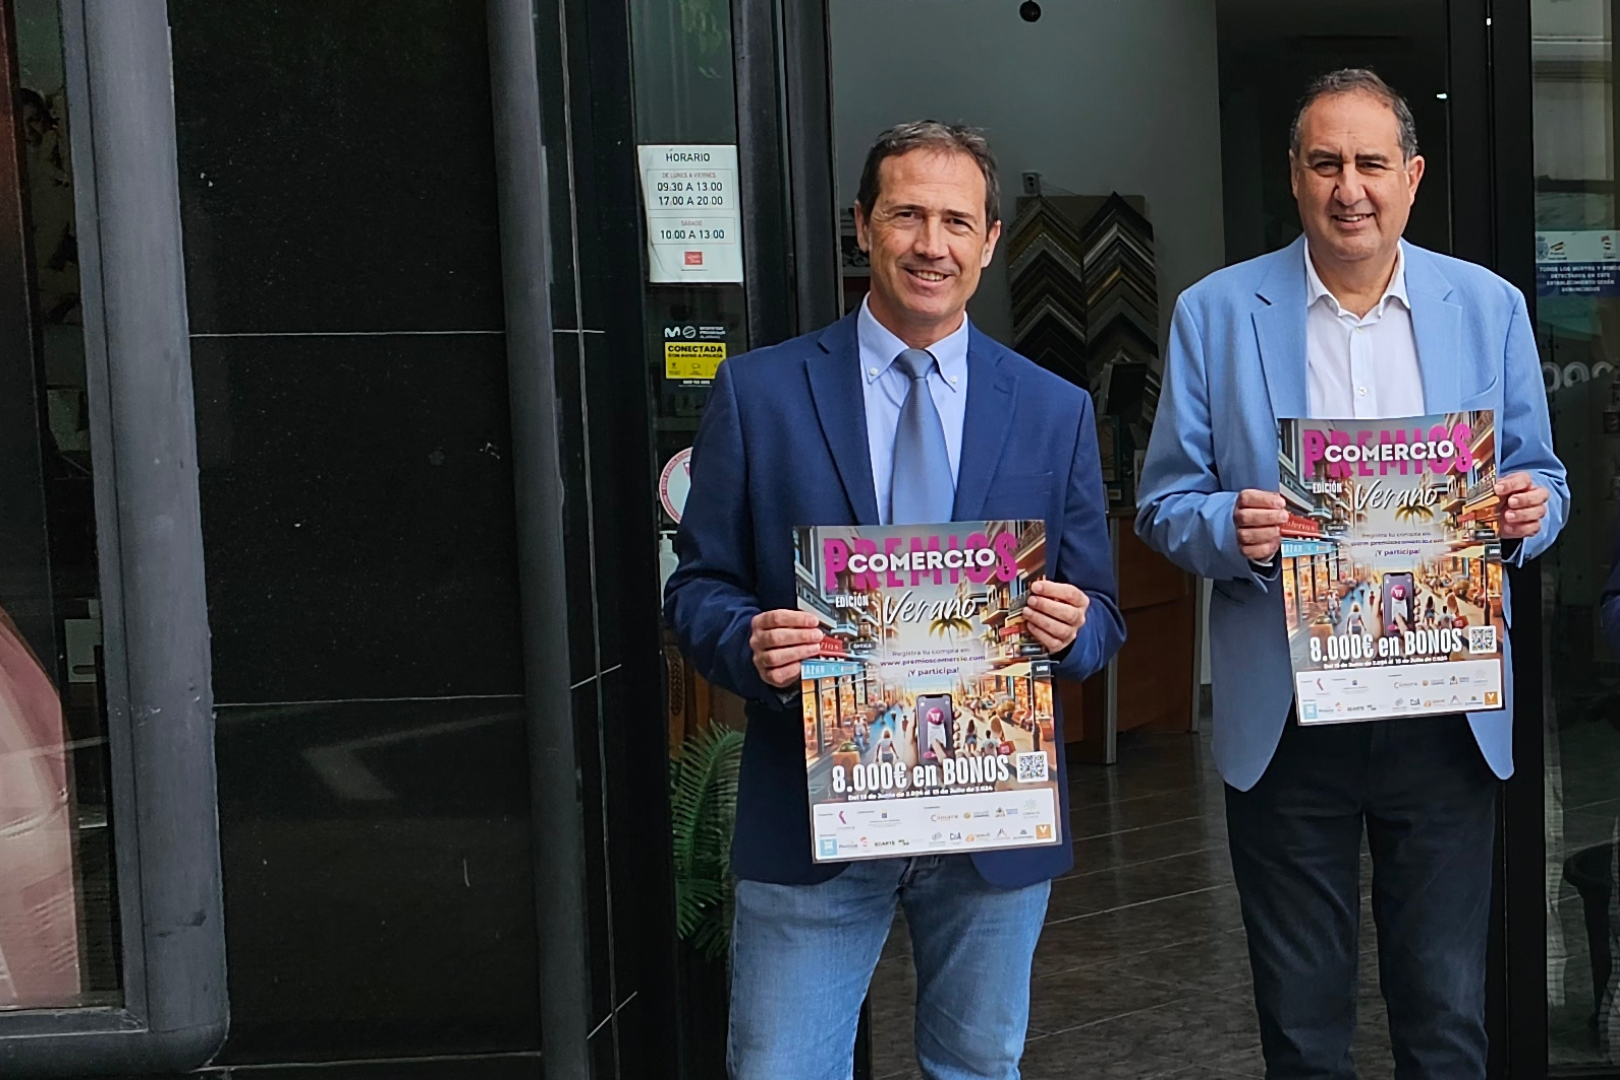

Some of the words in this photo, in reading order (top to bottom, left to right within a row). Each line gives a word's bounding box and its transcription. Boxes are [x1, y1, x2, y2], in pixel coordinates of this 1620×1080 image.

[666, 153, 711, 162] HORARIO
[685, 182, 694, 191] A
[686, 196, 695, 206] A
[688, 230, 697, 239] A
[667, 345, 723, 353] CONECTADA
[1303, 423, 1473, 478] PREMIOS
[1324, 440, 1455, 463] COMERCIO
[1353, 478, 1438, 510] Verano
[823, 531, 1019, 591] PREMIOS
[848, 548, 996, 574] COMERCIO
[835, 592, 870, 608] EDICIÓN
[883, 589, 977, 625] Verano
[1309, 632, 1374, 662] 8.000€
[1378, 635, 1400, 657] en
[1404, 627, 1463, 656] BONOS
[832, 761, 907, 793] 8.000€
[913, 764, 938, 788] en
[943, 754, 1010, 784] BONOS
